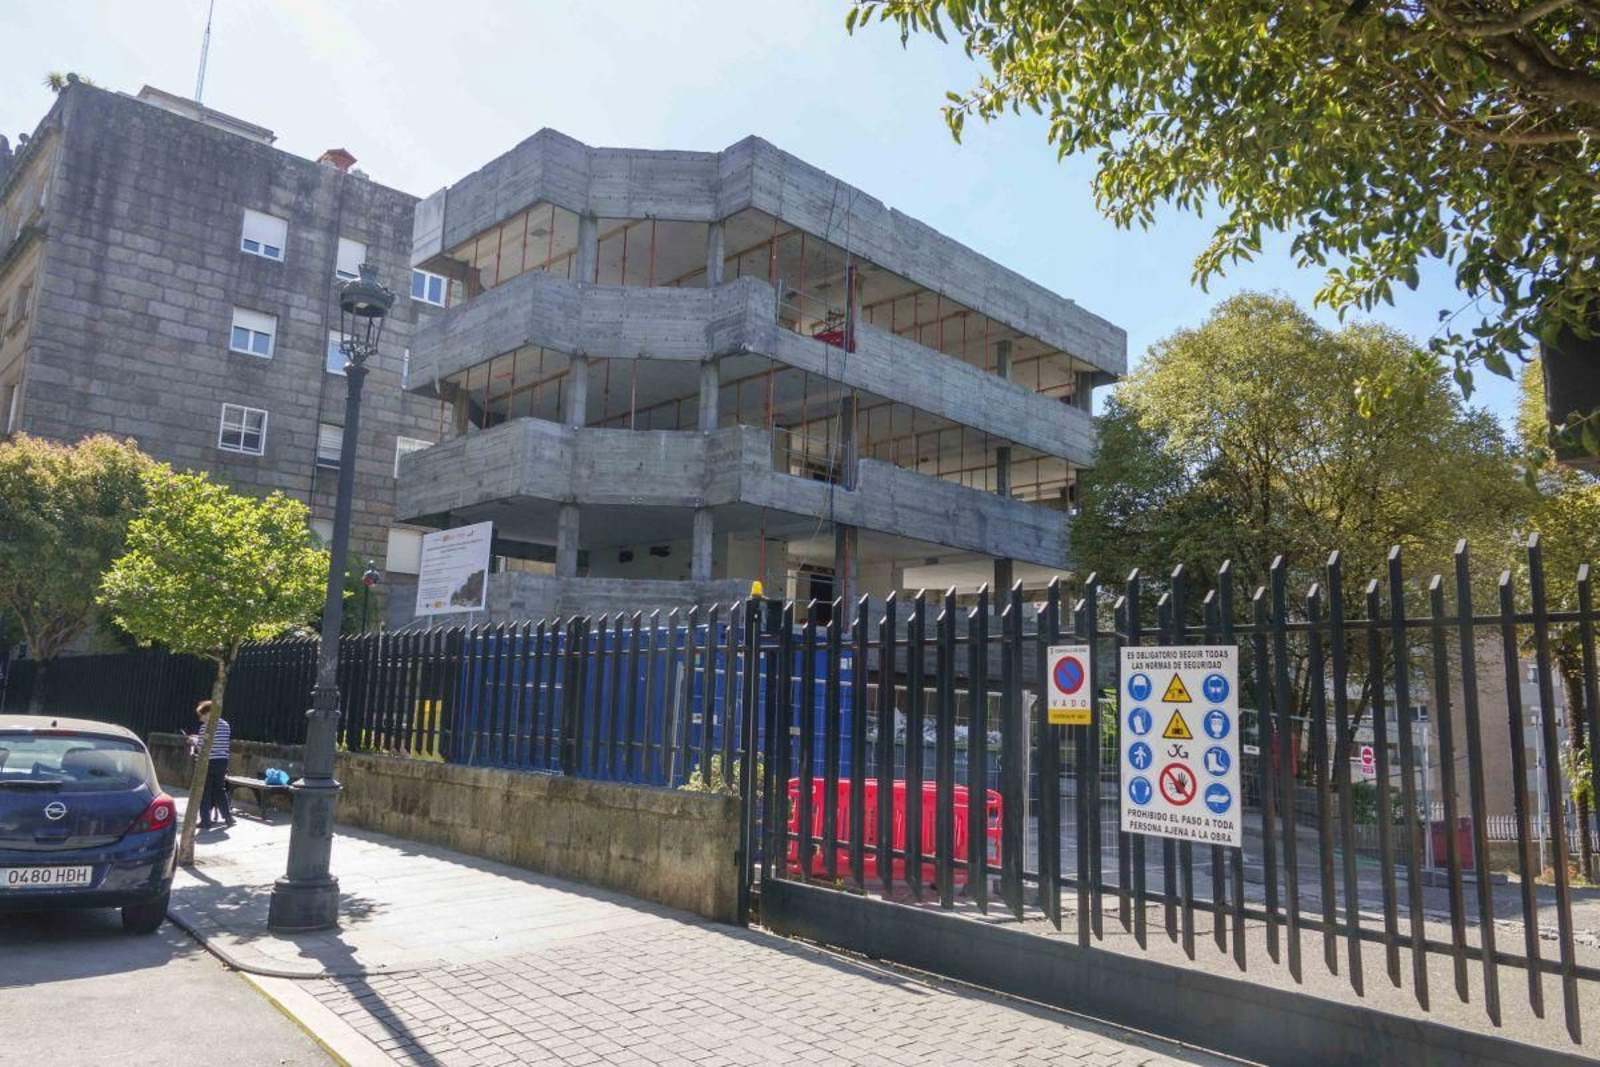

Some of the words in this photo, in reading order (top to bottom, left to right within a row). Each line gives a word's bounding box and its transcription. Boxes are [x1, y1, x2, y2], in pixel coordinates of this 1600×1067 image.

[1127, 651, 1135, 660] ES
[1136, 650, 1178, 660] OBLIGATORIO
[1179, 650, 1204, 659] SEGUIR
[1205, 650, 1229, 659] TODAS
[1131, 662, 1143, 670] LAS
[1145, 661, 1172, 670] NORMAS
[1173, 661, 1182, 669] DE
[1184, 661, 1222, 669] SEGURIDAD
[1052, 699, 1086, 708] VADO
[1127, 809, 1168, 821] PROHIBIDO
[1170, 815, 1179, 823] EL
[1181, 815, 1202, 826] PASO
[1204, 818, 1210, 827] A
[1213, 819, 1234, 830] TODA
[1129, 821, 1162, 832] PERSONA
[1164, 825, 1190, 836] AJENA
[1191, 829, 1197, 837] A
[1198, 830, 1208, 840] LA
[1210, 831, 1232, 843] OBRA
[8, 870, 52, 884] 0480
[56, 869, 87, 882] HDH
